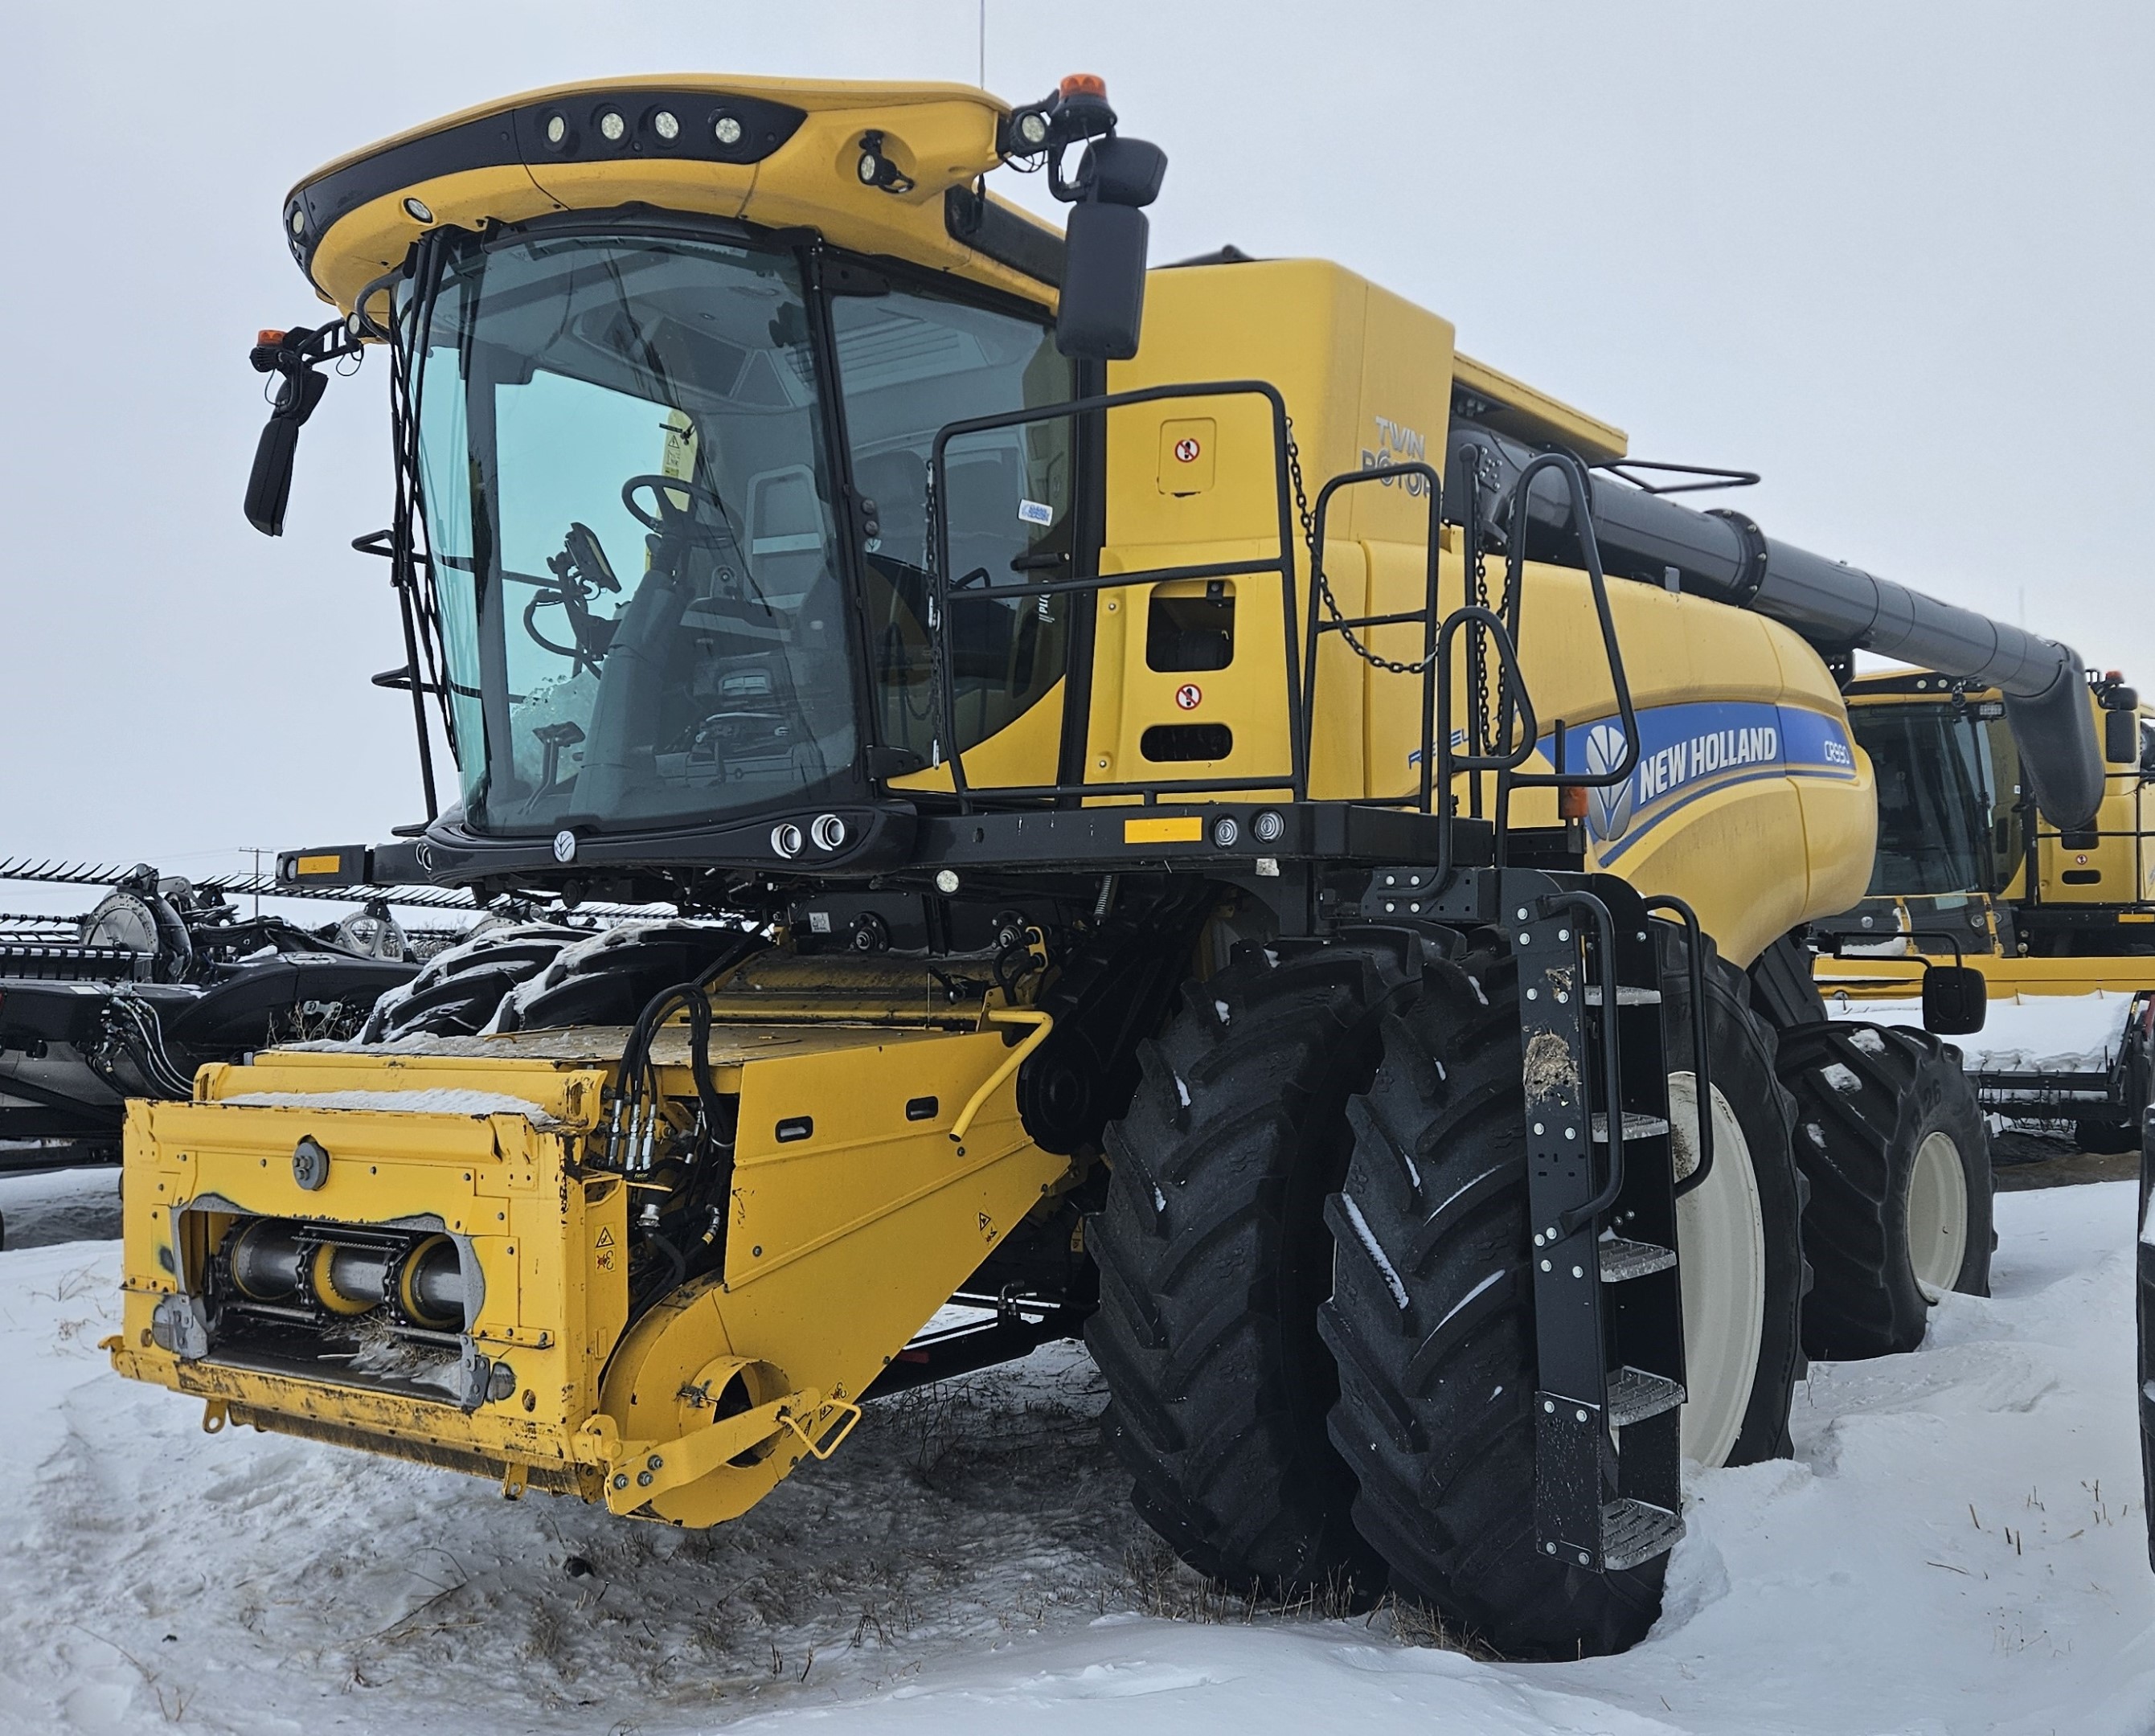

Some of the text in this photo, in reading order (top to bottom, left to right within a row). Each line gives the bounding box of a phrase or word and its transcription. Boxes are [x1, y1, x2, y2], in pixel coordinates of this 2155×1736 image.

[1375, 416, 1426, 461] TWIN
[1639, 727, 1778, 805] NEW HOLLAND
